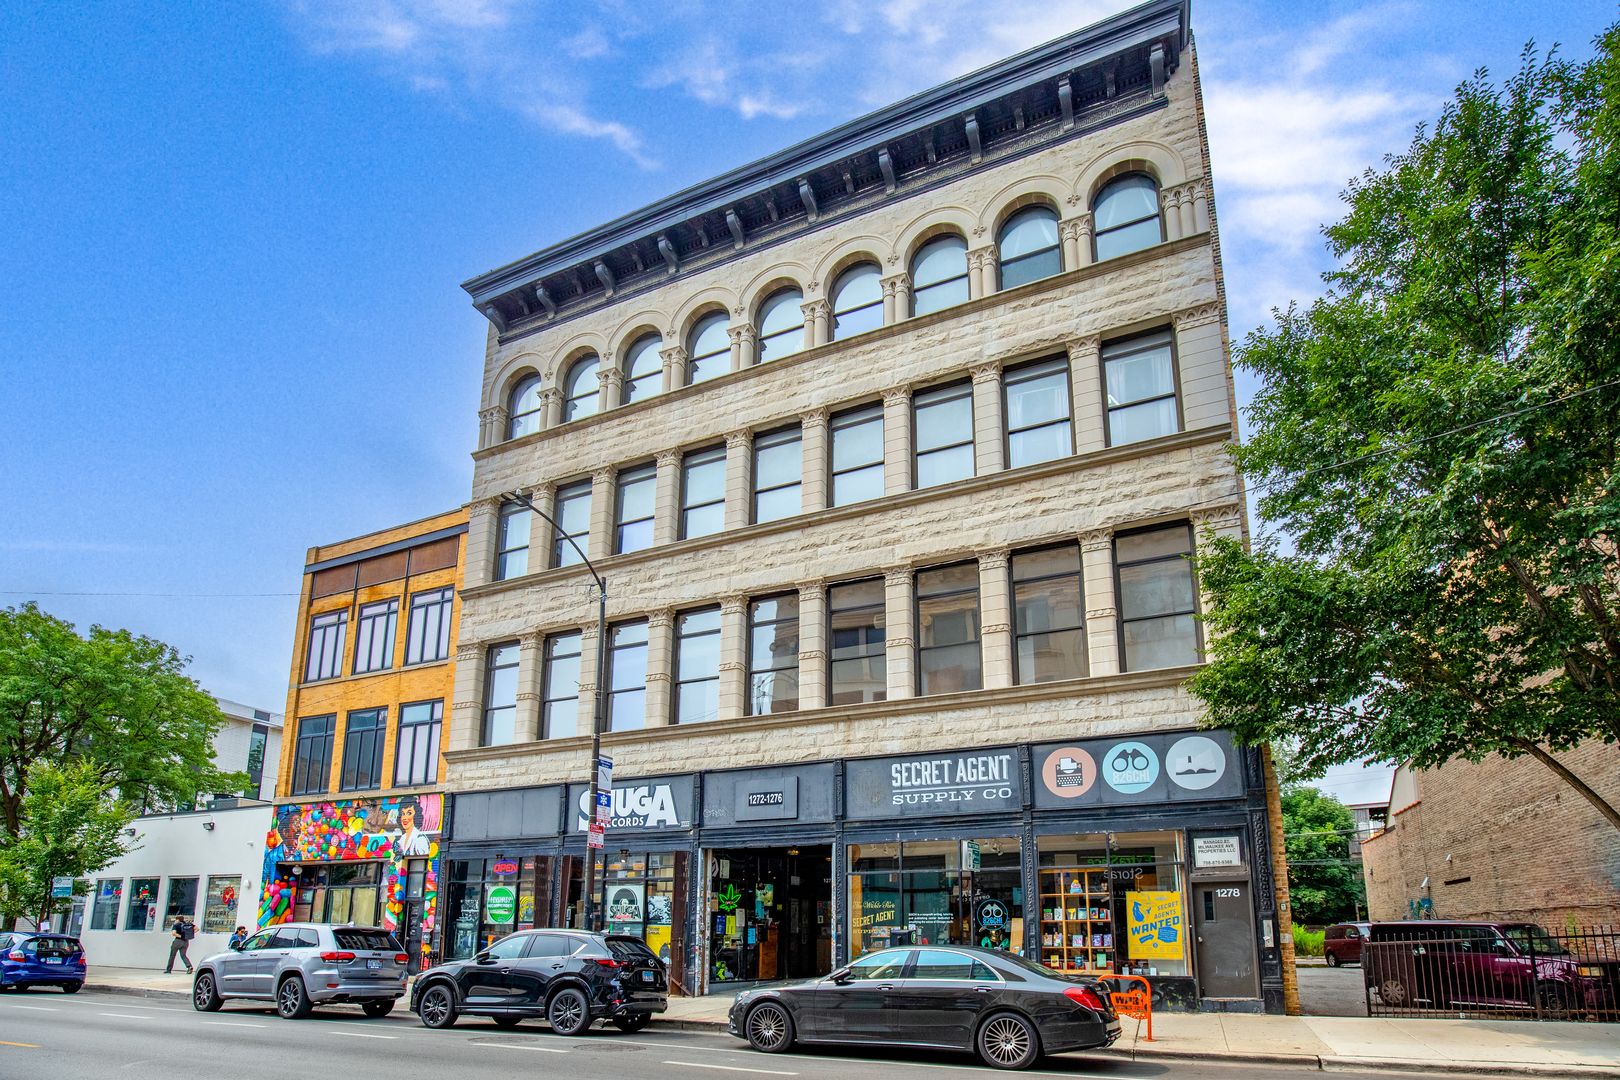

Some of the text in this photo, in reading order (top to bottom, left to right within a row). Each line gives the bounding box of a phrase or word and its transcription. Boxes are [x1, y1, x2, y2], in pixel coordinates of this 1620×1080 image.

[891, 755, 1011, 787] SECRET AGENT
[1112, 769, 1150, 783] 826CHI
[748, 792, 783, 805] 1272-1276
[892, 787, 1012, 805] SUPPLY CO
[493, 863, 519, 873] OPEN
[1215, 888, 1240, 897] 1278
[1157, 901, 1178, 911] SECRET
[852, 910, 895, 927] SECRET AGENT
[1154, 909, 1176, 919] AGENTS
[1131, 916, 1179, 936] WANTED
